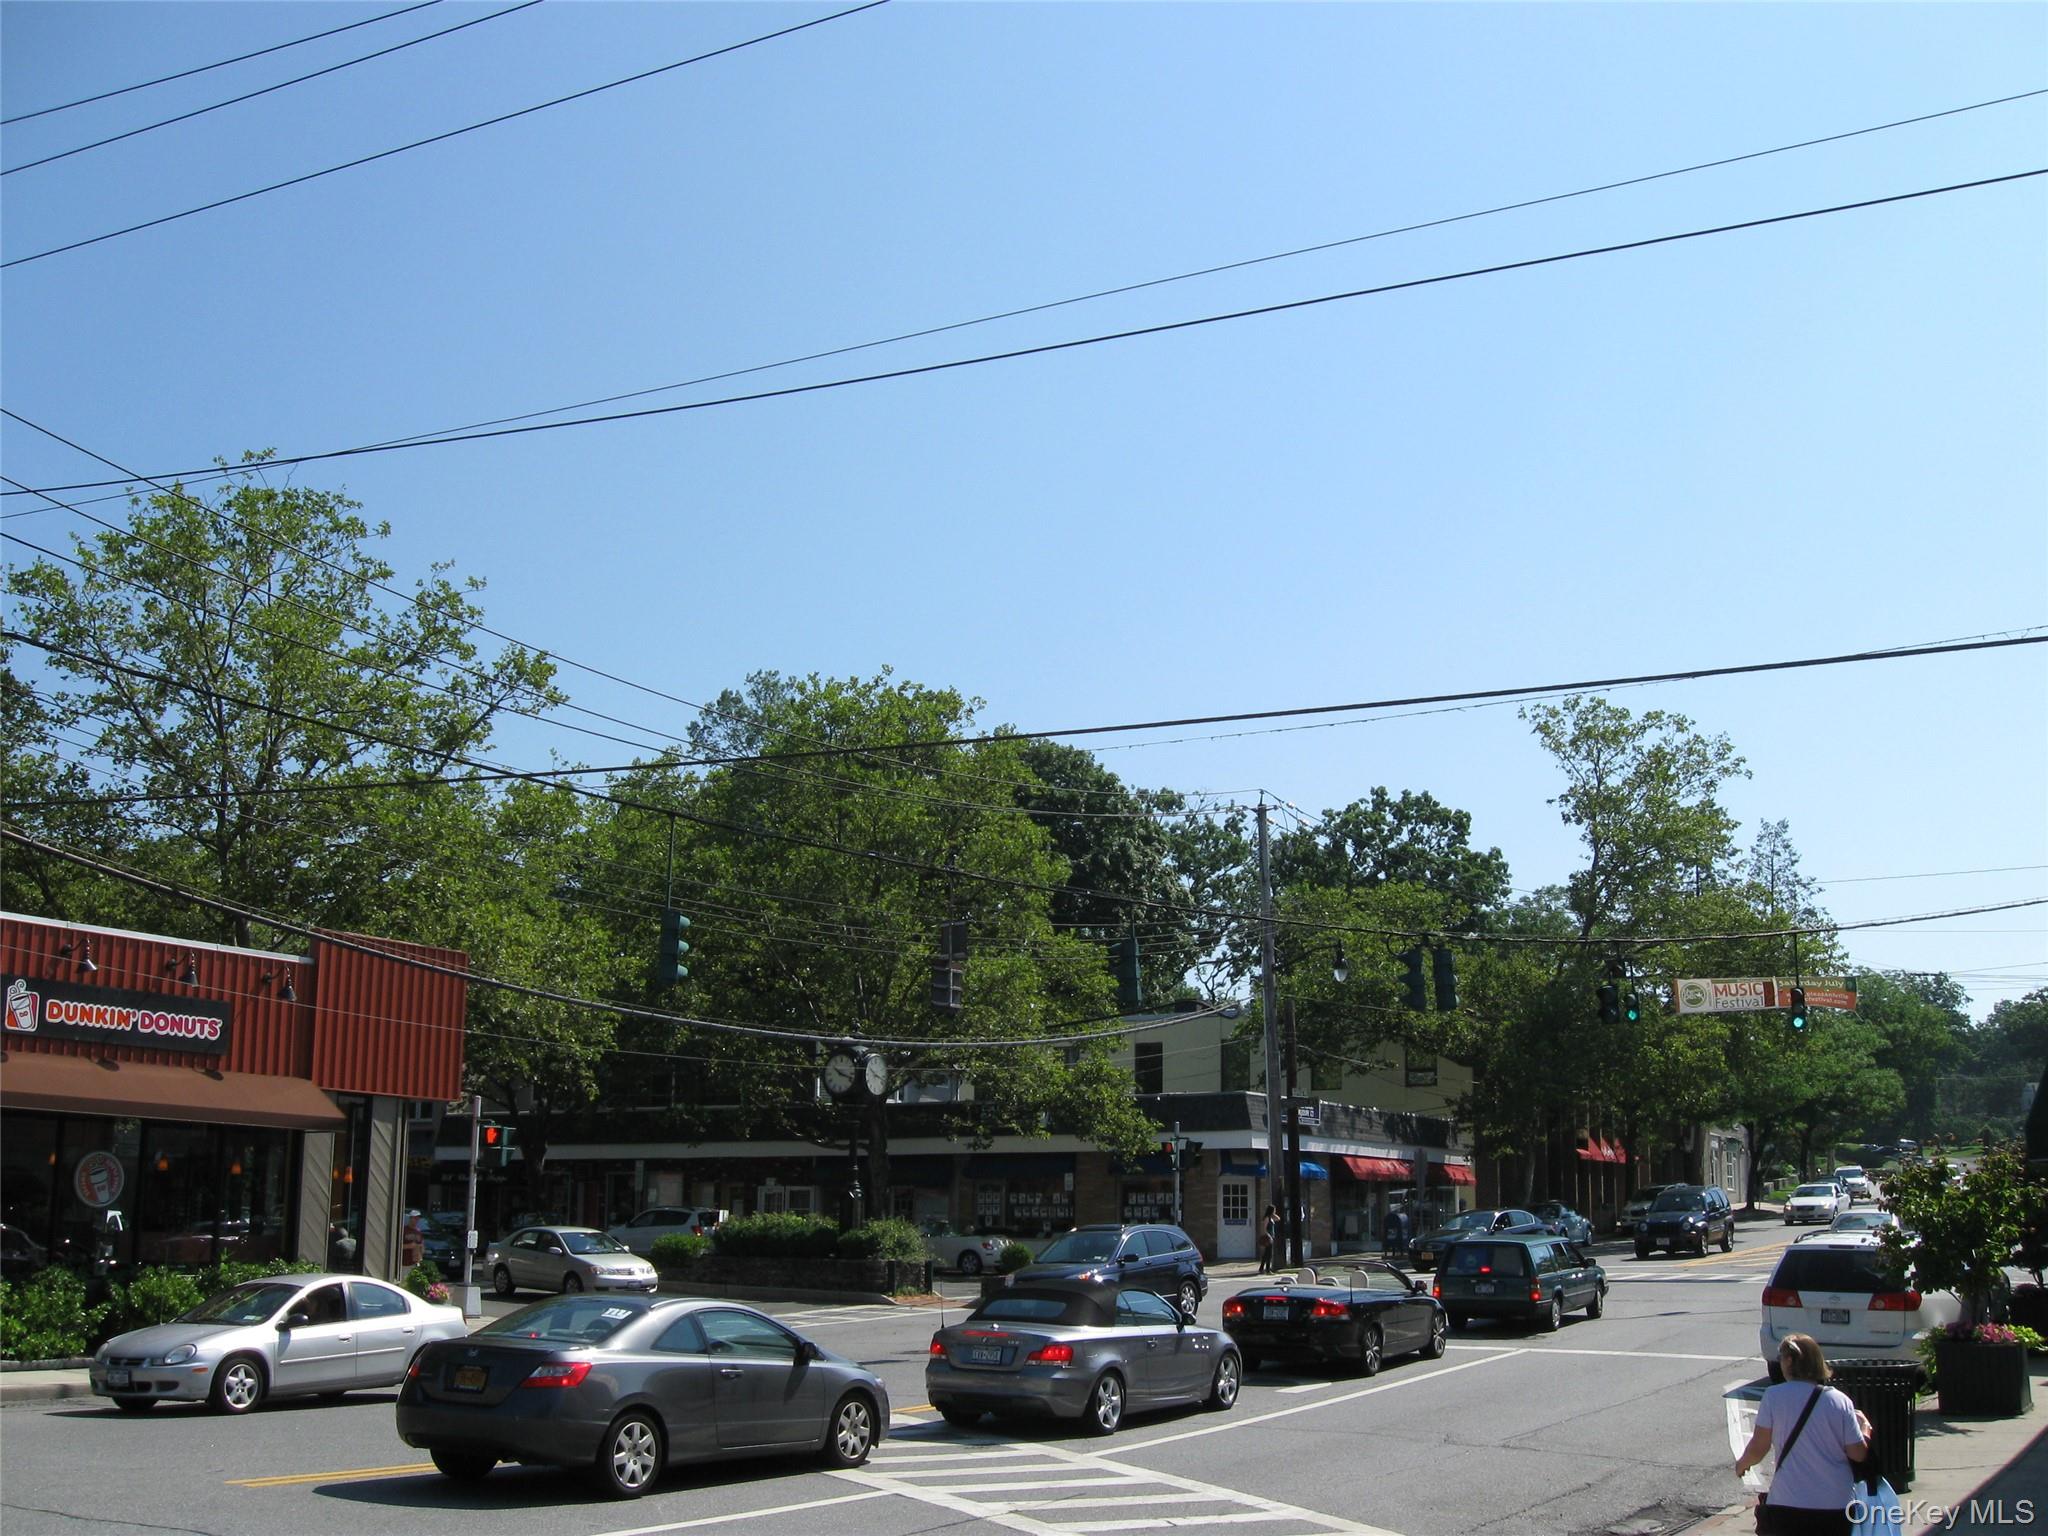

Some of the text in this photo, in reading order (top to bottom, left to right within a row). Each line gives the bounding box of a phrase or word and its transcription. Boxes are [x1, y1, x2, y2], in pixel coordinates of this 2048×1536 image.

[1824, 979, 1844, 988] July
[1714, 983, 1763, 998] MUSIC
[1715, 996, 1764, 1008] Festival
[46, 999, 223, 1040] DUNKIN' DONUTS
